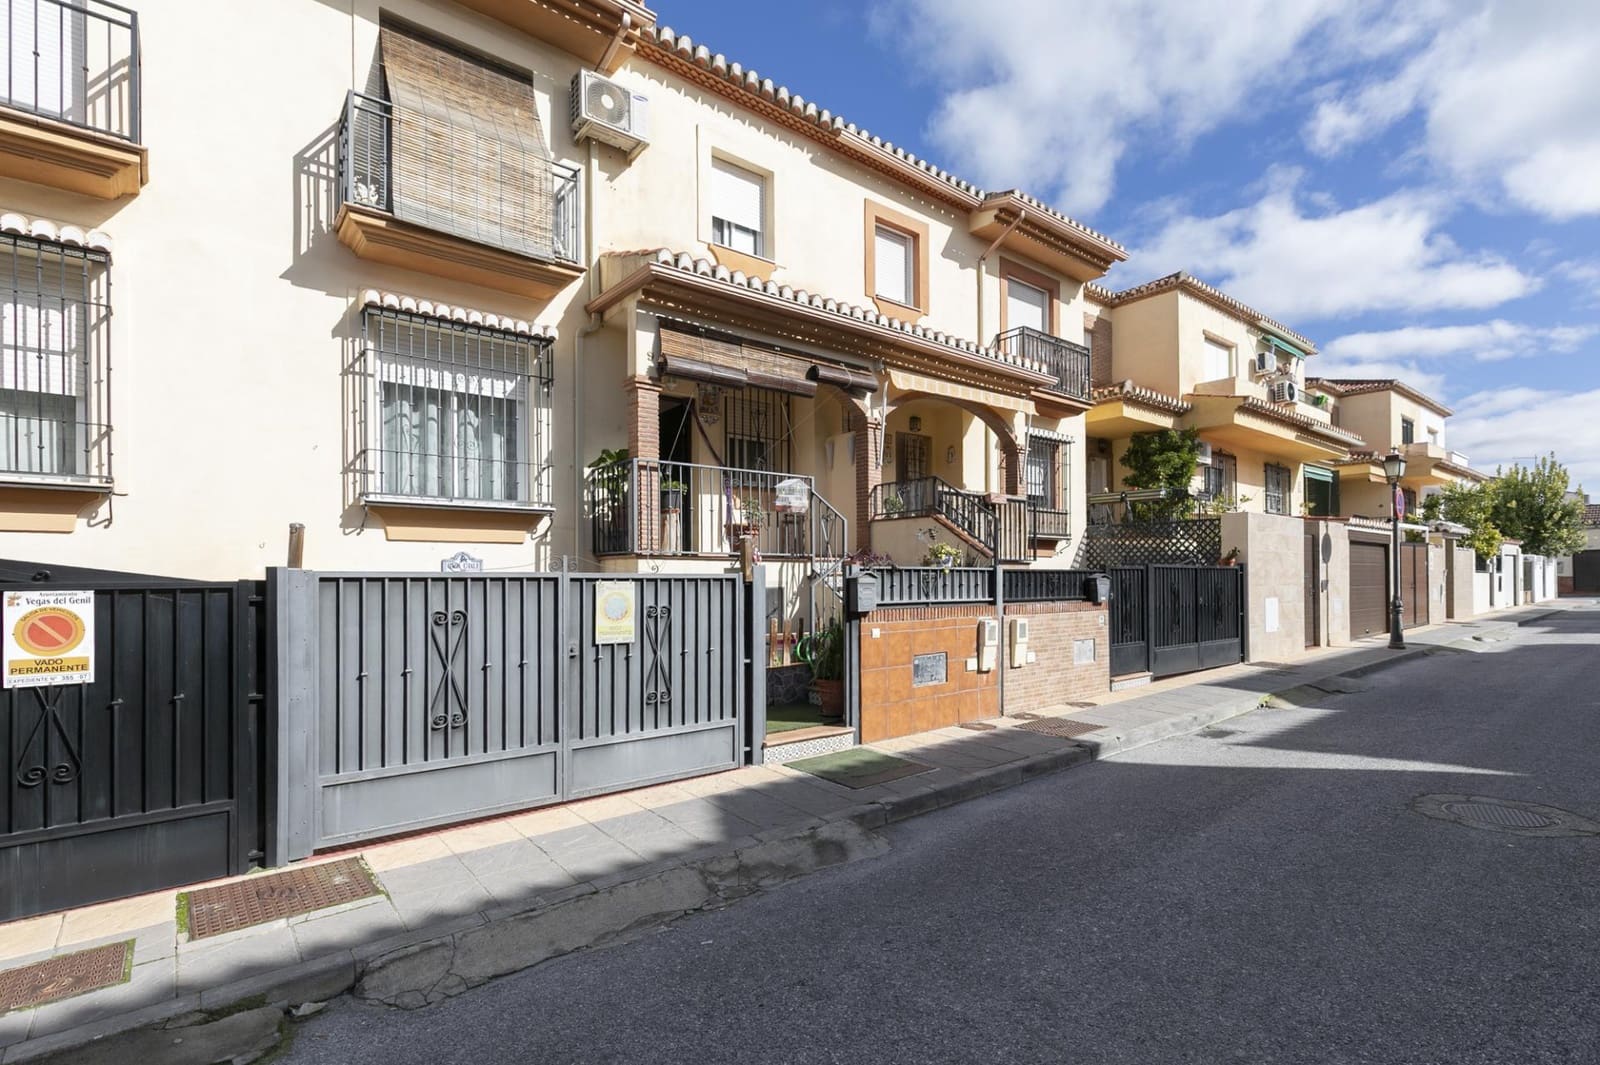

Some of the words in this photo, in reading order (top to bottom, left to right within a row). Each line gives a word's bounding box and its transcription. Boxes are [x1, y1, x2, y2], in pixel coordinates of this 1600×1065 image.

[25, 597, 51, 606] Vegas
[53, 597, 67, 605] del
[69, 596, 91, 604] Genil
[34, 658, 64, 666] VADO
[10, 663, 89, 675] PERMANENTE
